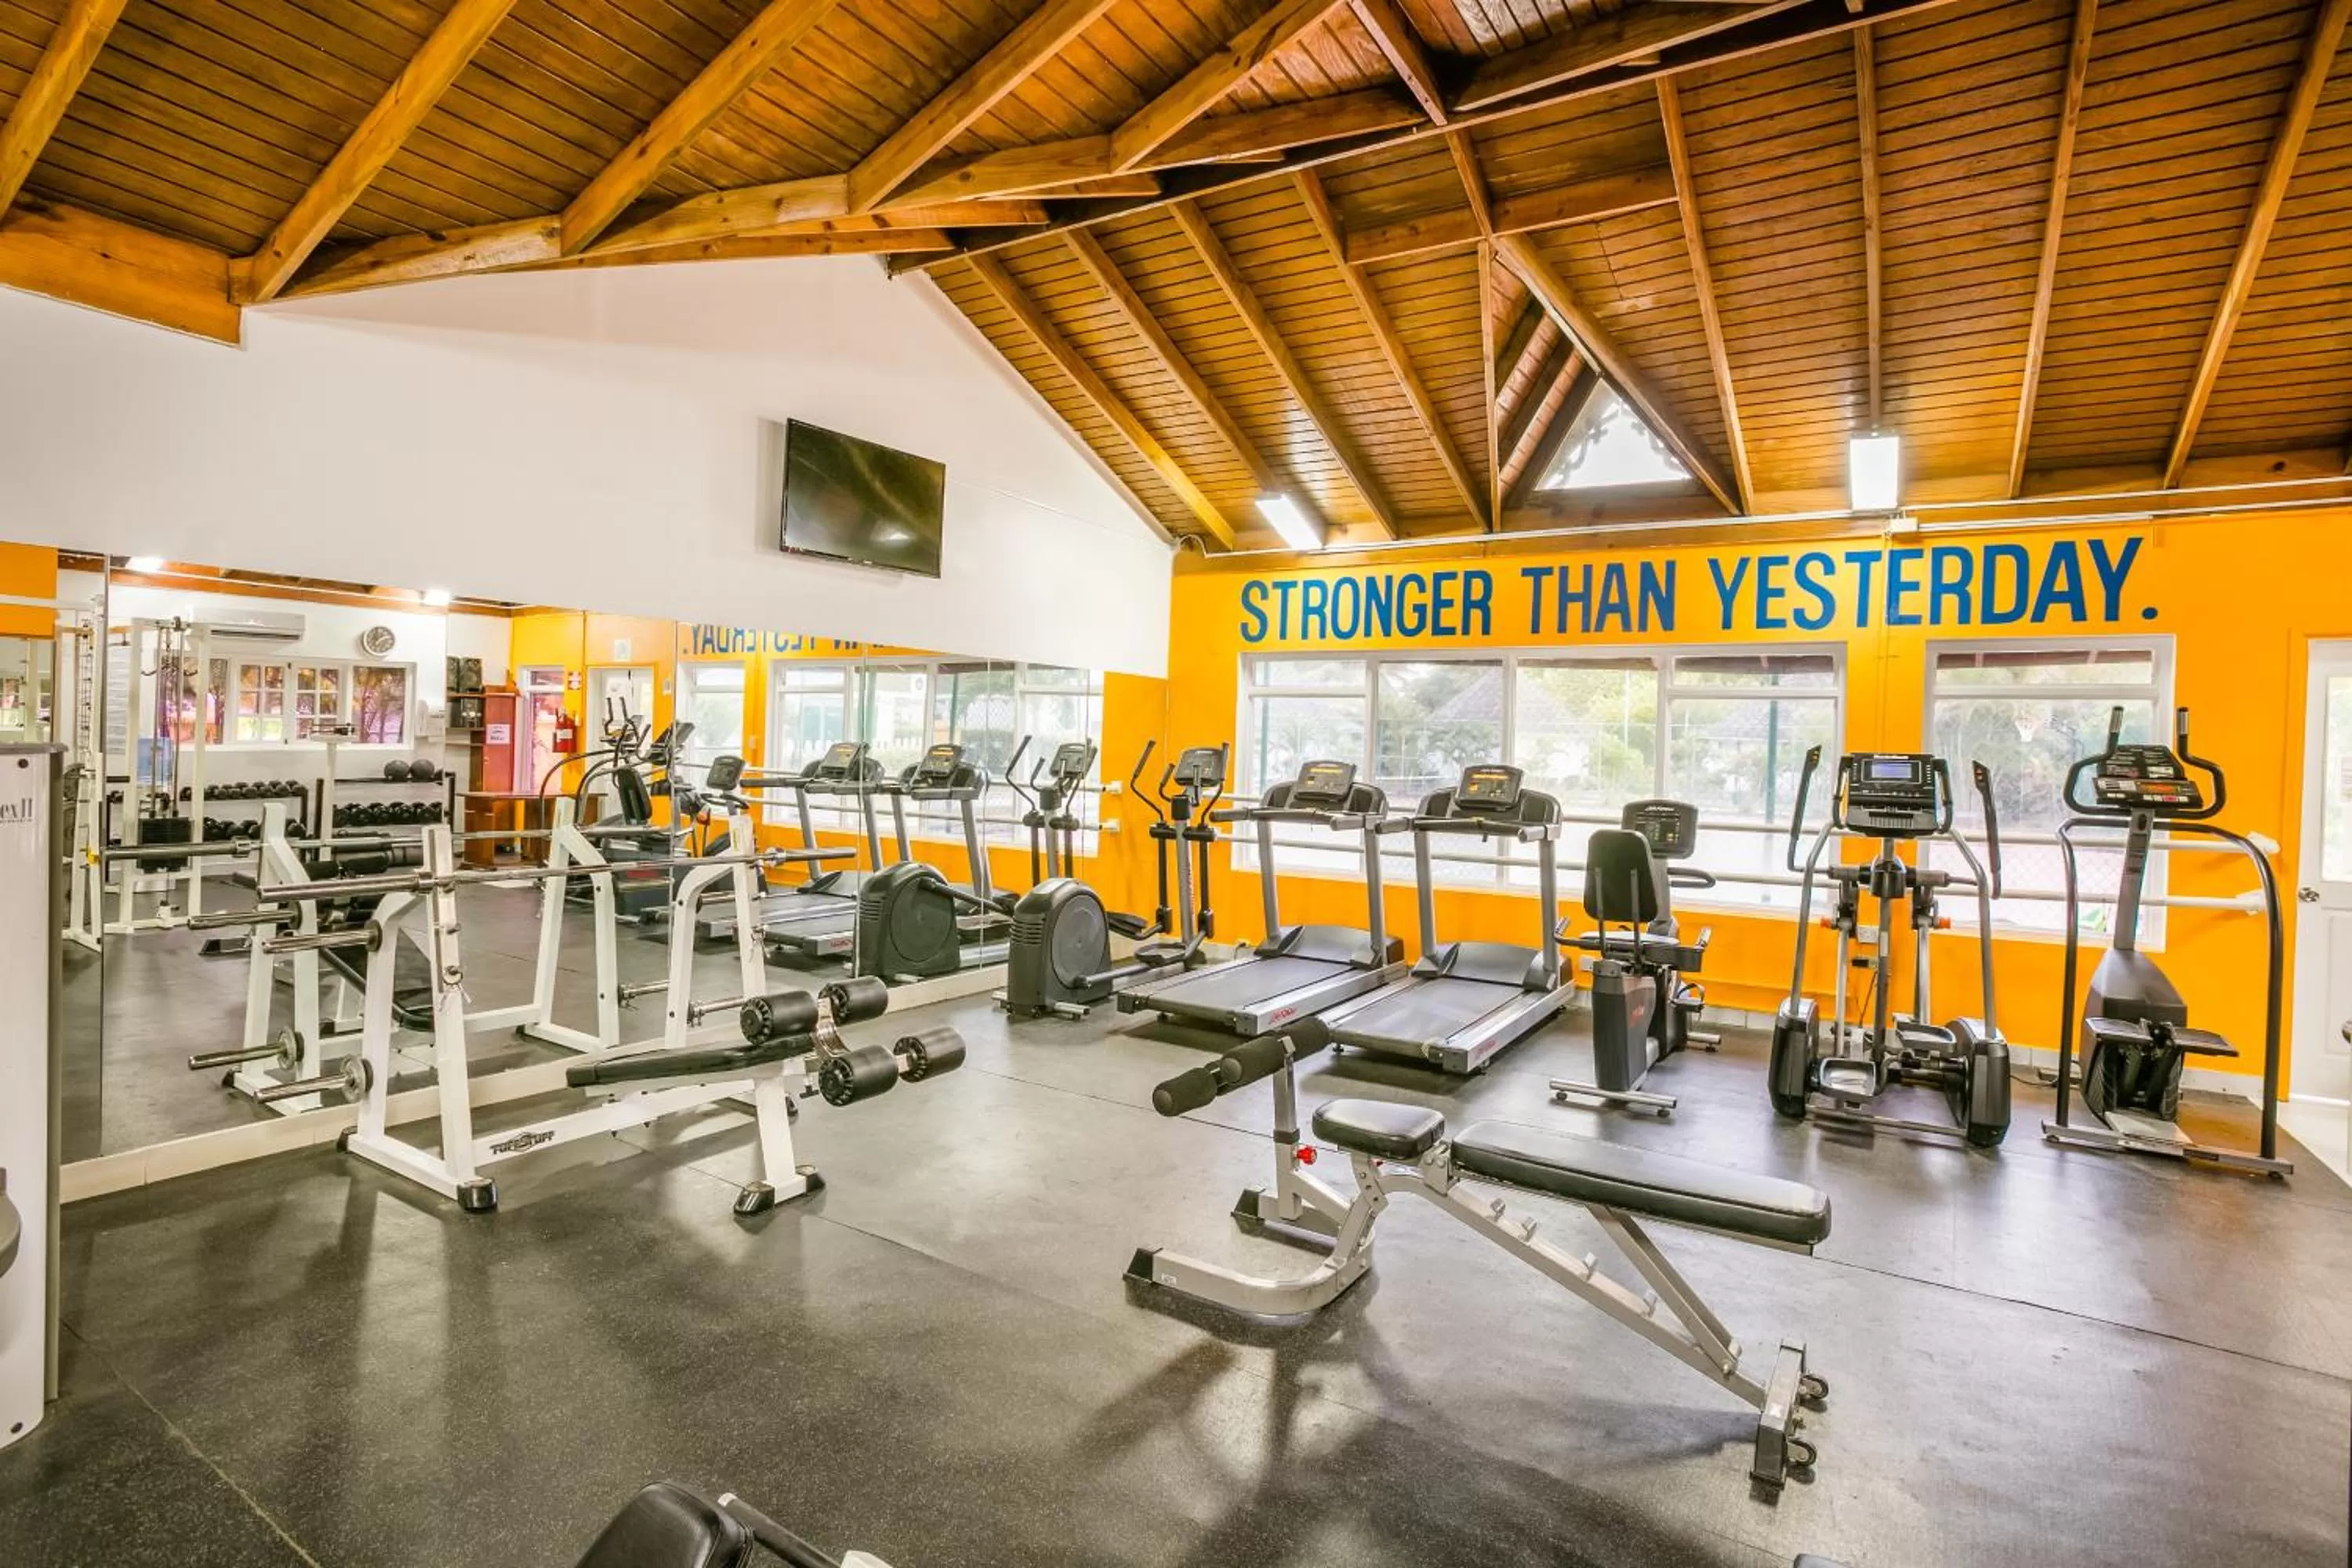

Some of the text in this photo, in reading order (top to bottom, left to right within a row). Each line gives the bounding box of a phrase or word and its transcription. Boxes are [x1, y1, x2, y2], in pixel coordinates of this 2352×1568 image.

[1240, 537, 2158, 643] STRONGER THAN YESTERDAY.
